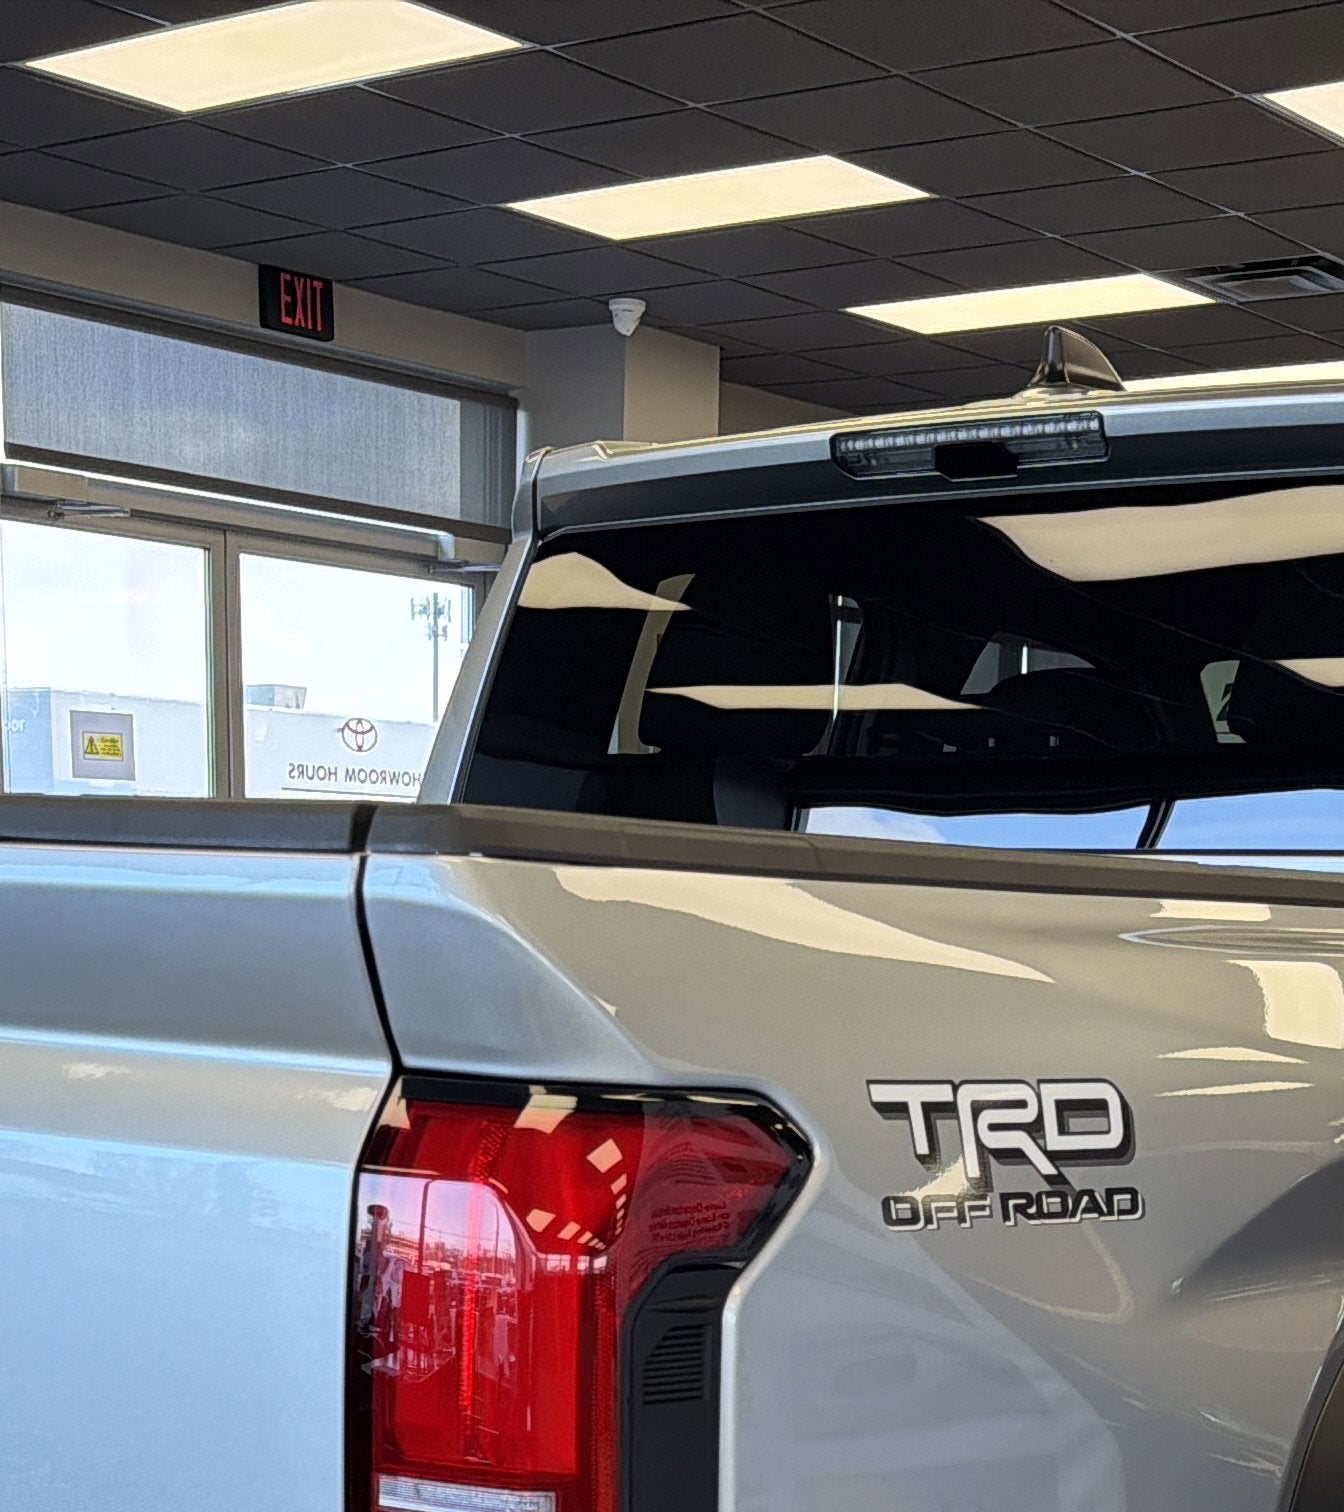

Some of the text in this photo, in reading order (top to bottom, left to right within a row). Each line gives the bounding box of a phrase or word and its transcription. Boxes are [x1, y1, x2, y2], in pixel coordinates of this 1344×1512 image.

[280, 272, 323, 332] EXIT
[866, 1078, 1136, 1192] TRD
[881, 1186, 1146, 1232] OFF ROAD
